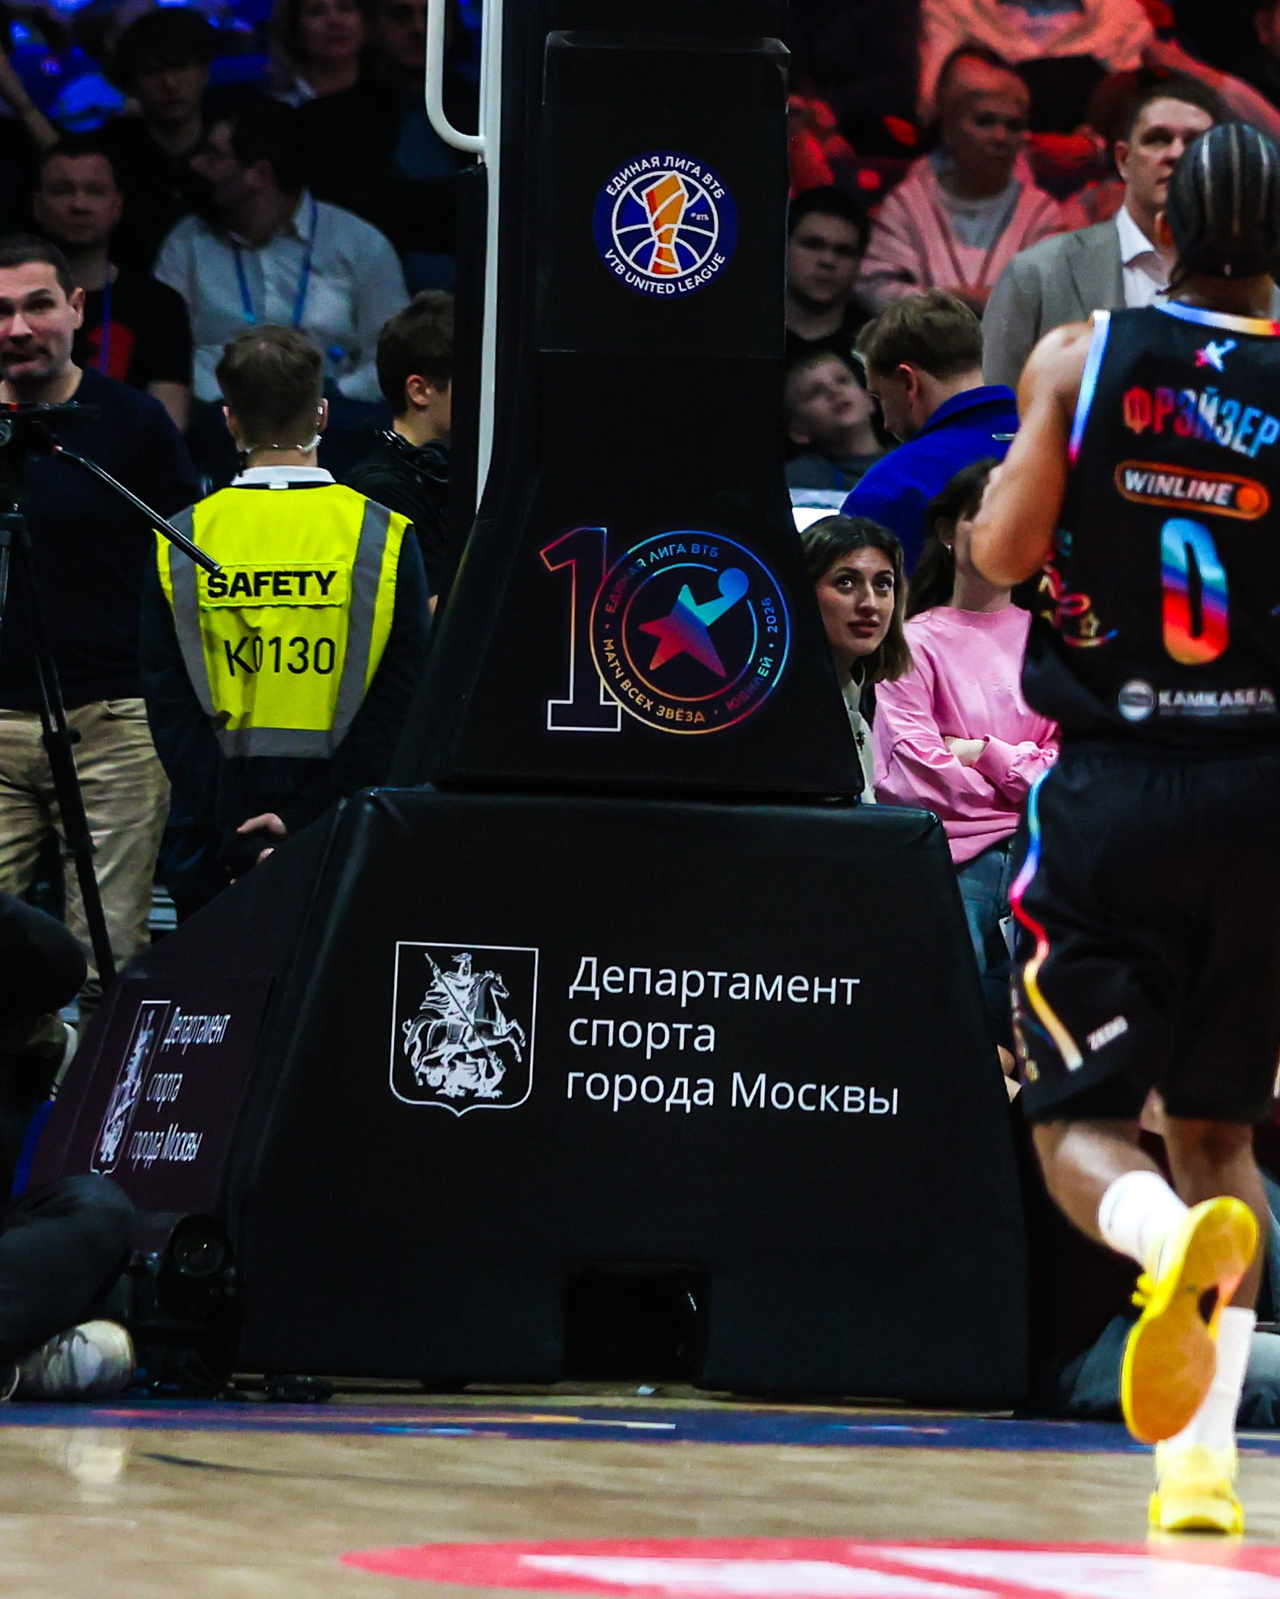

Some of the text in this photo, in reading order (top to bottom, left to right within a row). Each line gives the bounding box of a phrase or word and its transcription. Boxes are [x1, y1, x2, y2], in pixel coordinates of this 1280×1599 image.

[605, 155, 726, 200] ЕДИНАЯ ЛИГА ВТБ
[604, 248, 726, 295] VTB UNITED LEAGUE
[1124, 469, 1236, 506] WINLINE
[649, 542, 687, 563] ЛИГА
[691, 542, 720, 558] ВТБ
[206, 570, 338, 599] SAFETY
[1160, 517, 1230, 666] 0
[760, 596, 779, 634] 2026
[223, 635, 337, 677] K0130
[602, 637, 707, 724] МАТЧ ВСЕХ ЗВЁЗД
[568, 955, 862, 1008] Департамент
[568, 1016, 717, 1060] спорта
[566, 1070, 899, 1116] города Москвы
[160, 1123, 204, 1162] Москвы
